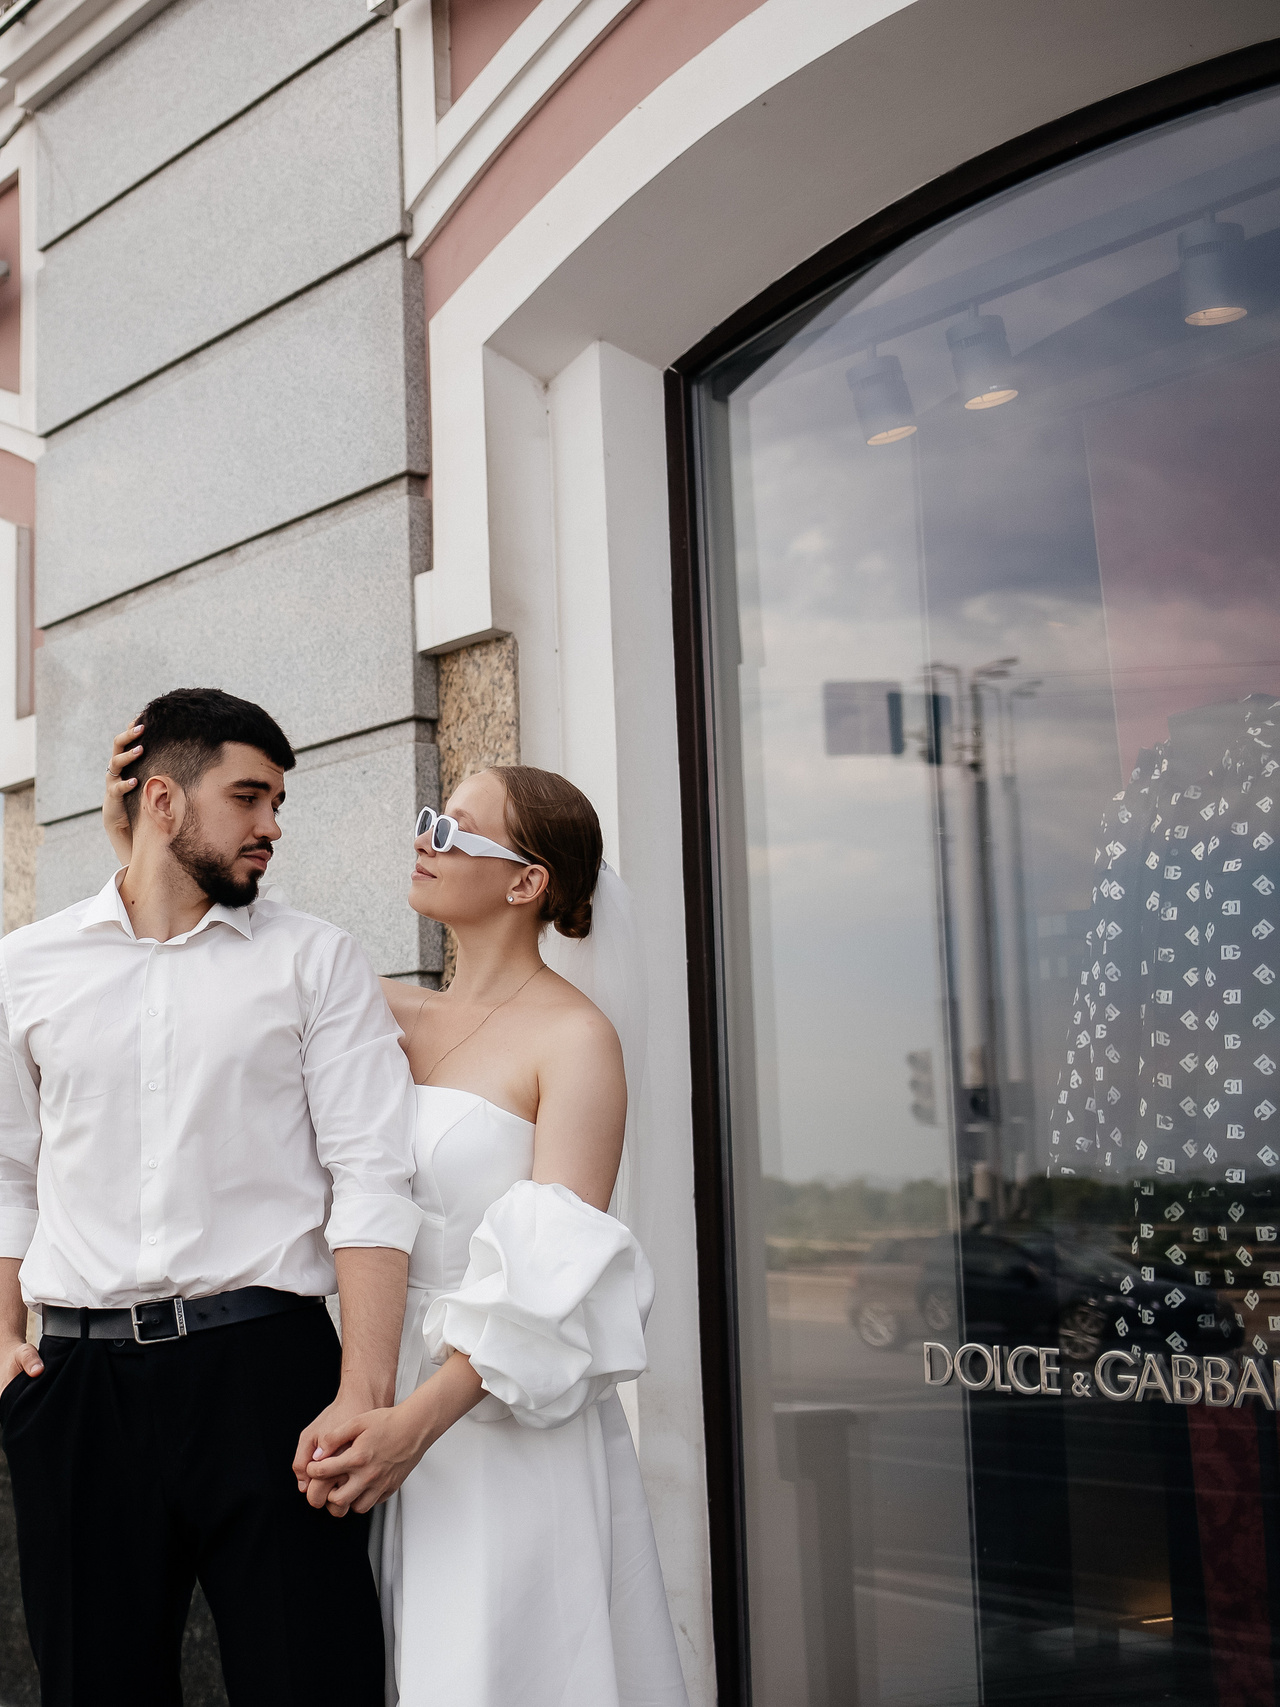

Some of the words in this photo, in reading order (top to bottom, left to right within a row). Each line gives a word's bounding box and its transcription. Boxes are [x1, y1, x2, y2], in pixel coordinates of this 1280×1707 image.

[1164, 866, 1181, 880] DG
[1222, 859, 1242, 872] DG
[1252, 875, 1275, 895] DG
[1221, 945, 1241, 960] DG
[1252, 964, 1275, 984] DG
[1224, 1034, 1241, 1049] DG
[1253, 1054, 1276, 1075] DG
[1227, 1124, 1245, 1139] DG
[1257, 1145, 1279, 1166] DG
[1141, 1224, 1154, 1238] DG
[1256, 1226, 1277, 1241] DG
[1165, 1244, 1186, 1265] DG
[1236, 1246, 1253, 1267] DG
[1165, 1331, 1188, 1352] DG
[923, 1341, 1062, 1396] DOLCE
[1071, 1371, 1092, 1398] &
